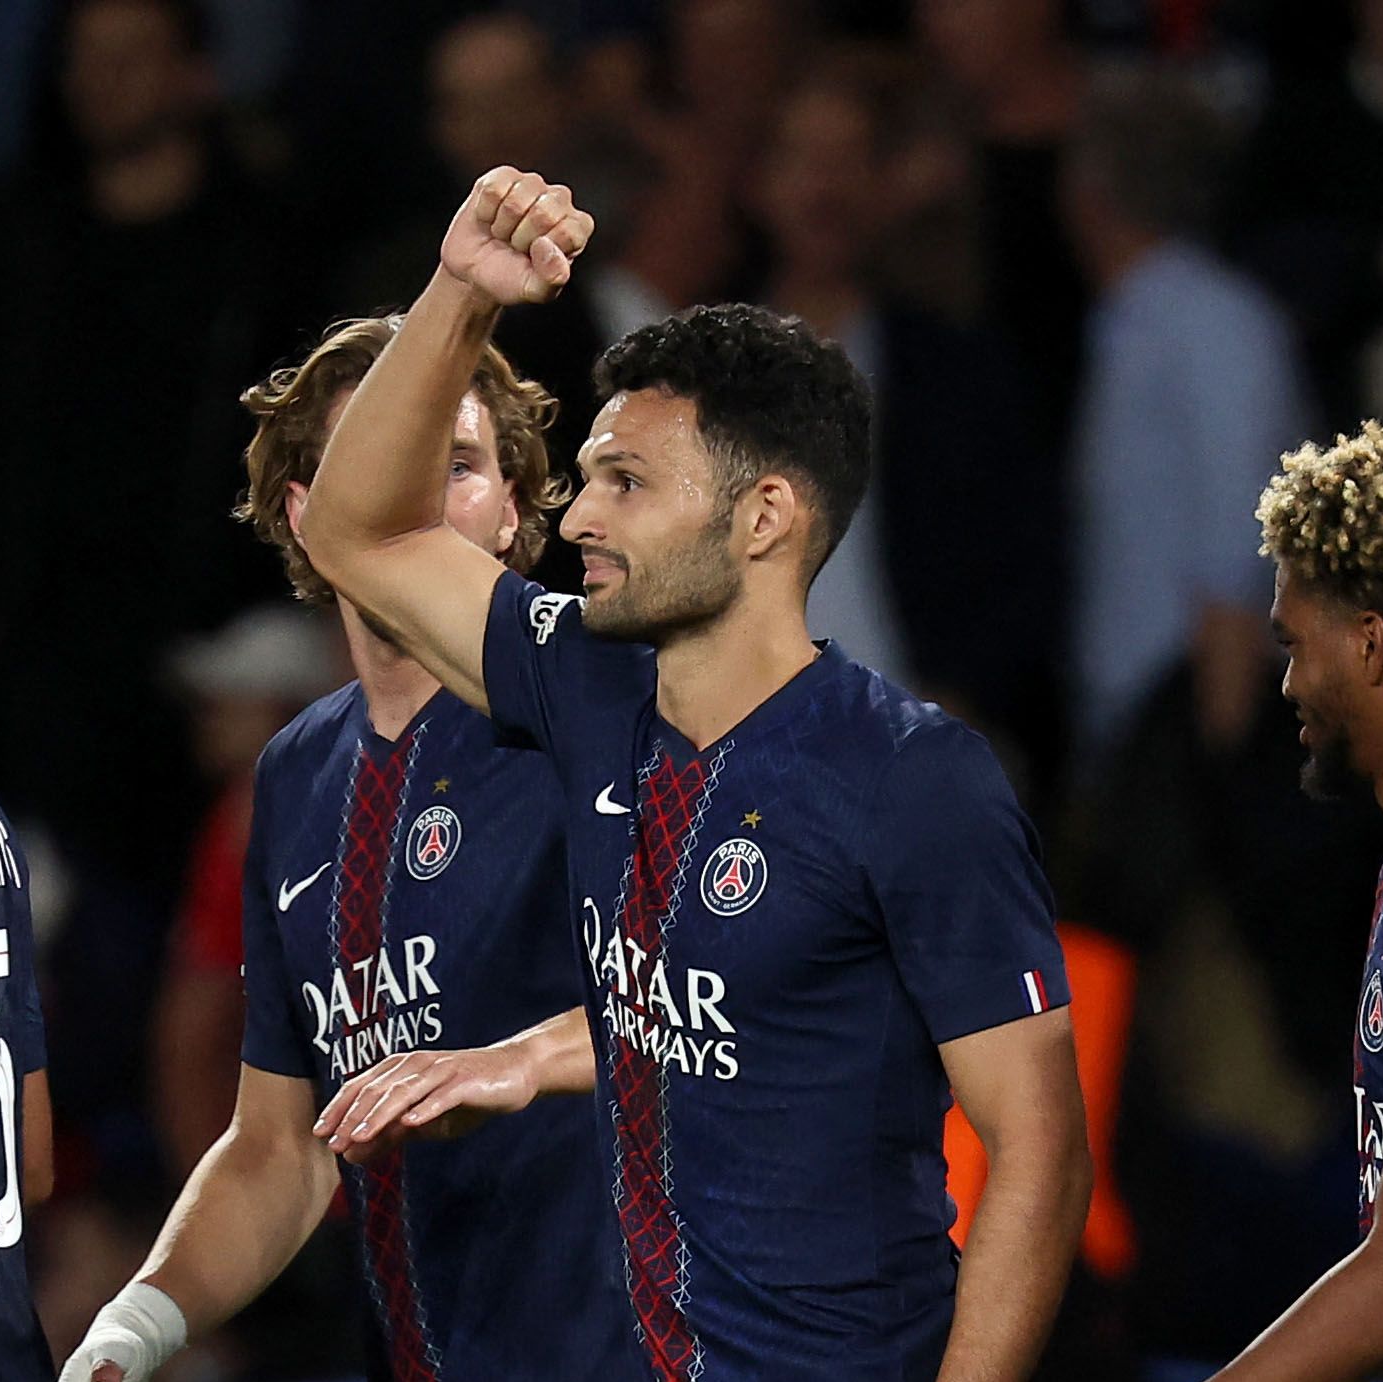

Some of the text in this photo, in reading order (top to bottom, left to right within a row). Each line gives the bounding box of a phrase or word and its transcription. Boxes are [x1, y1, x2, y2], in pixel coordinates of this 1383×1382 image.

[416, 809, 454, 832] PARIS
[718, 842, 760, 865] PARIS
[300, 933, 442, 1056] QATAR
[330, 1001, 444, 1081] AIRWAYS
[601, 990, 740, 1081] AIRWAYS
